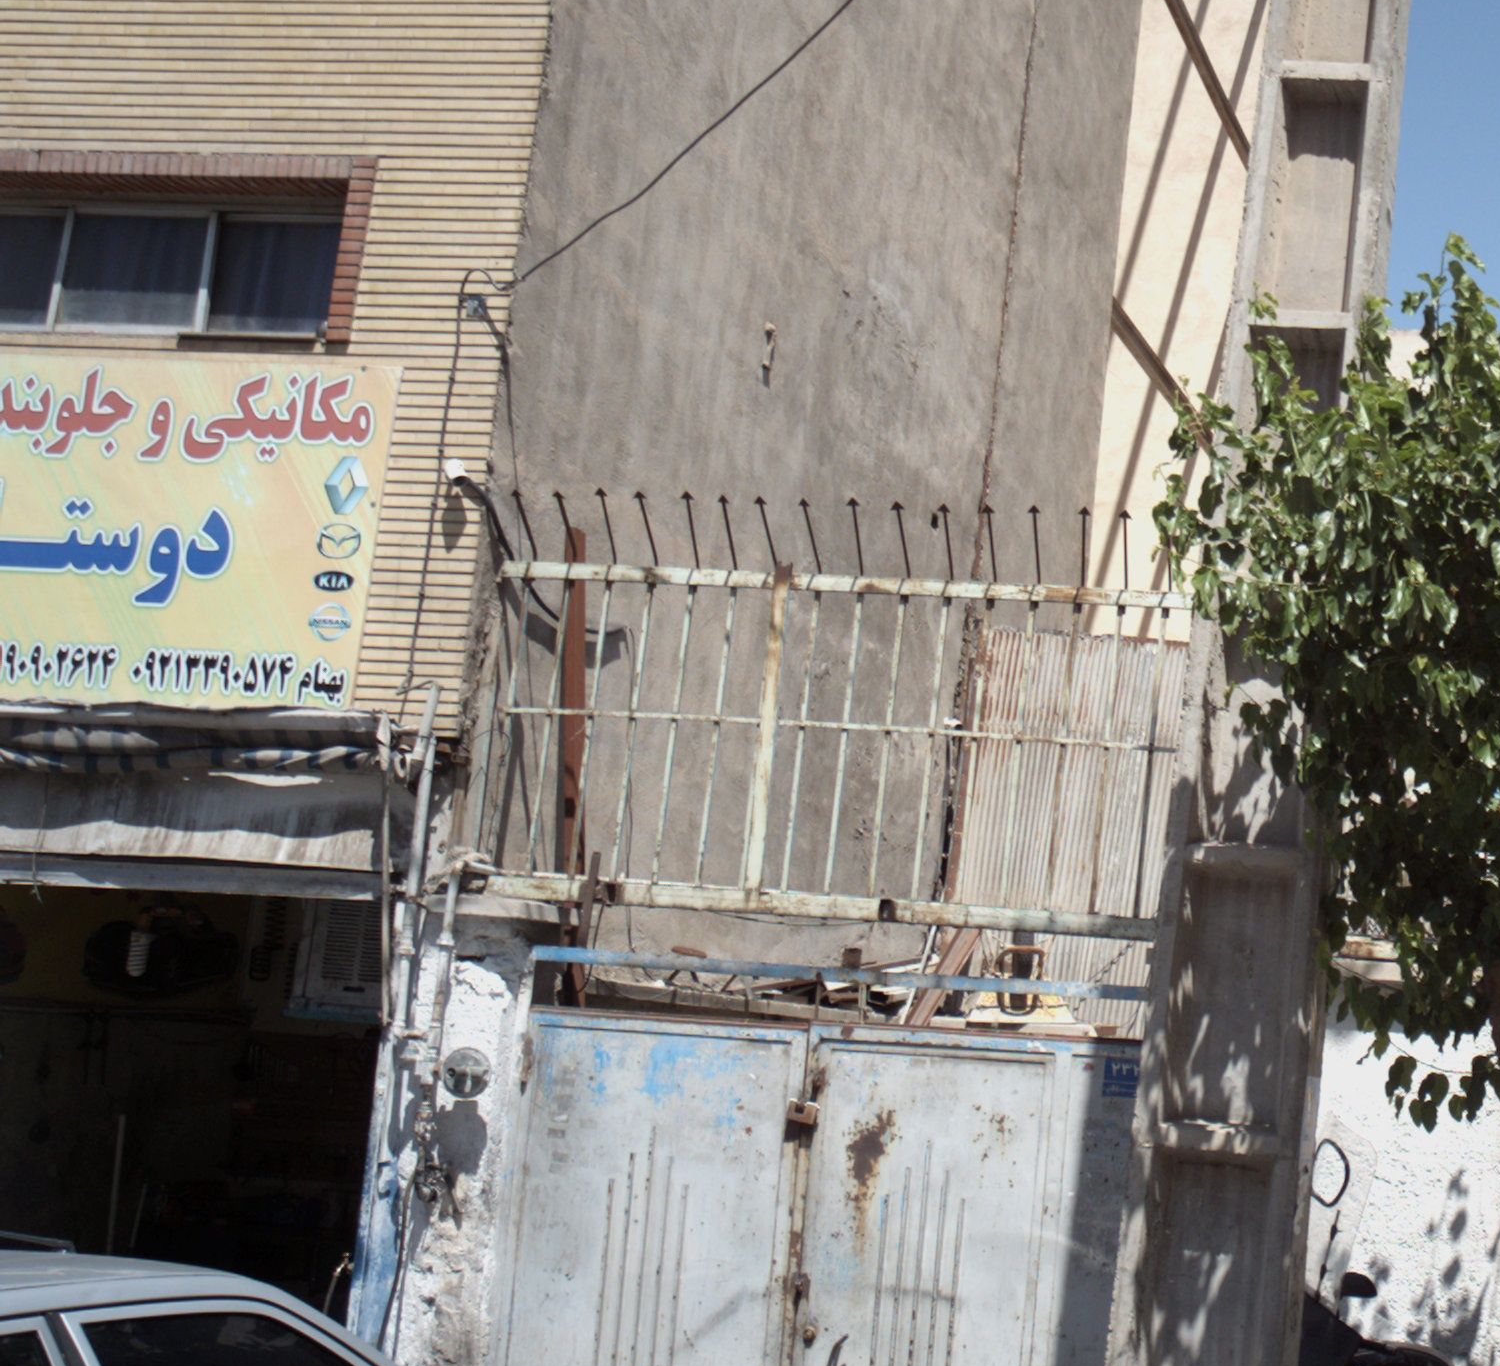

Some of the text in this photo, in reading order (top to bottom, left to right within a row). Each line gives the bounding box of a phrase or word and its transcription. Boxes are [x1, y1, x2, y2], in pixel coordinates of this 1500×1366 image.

[140, 400, 172, 458] و
[184, 375, 372, 460] مکانیکی
[0, 499, 231, 604] دوست
[318, 575, 348, 588] KIA
[0, 643, 345, 703] بهنام ۰۹۲۱۳۳۹۰۵۷۴ ۹۰۹۰۲۶۲۴
